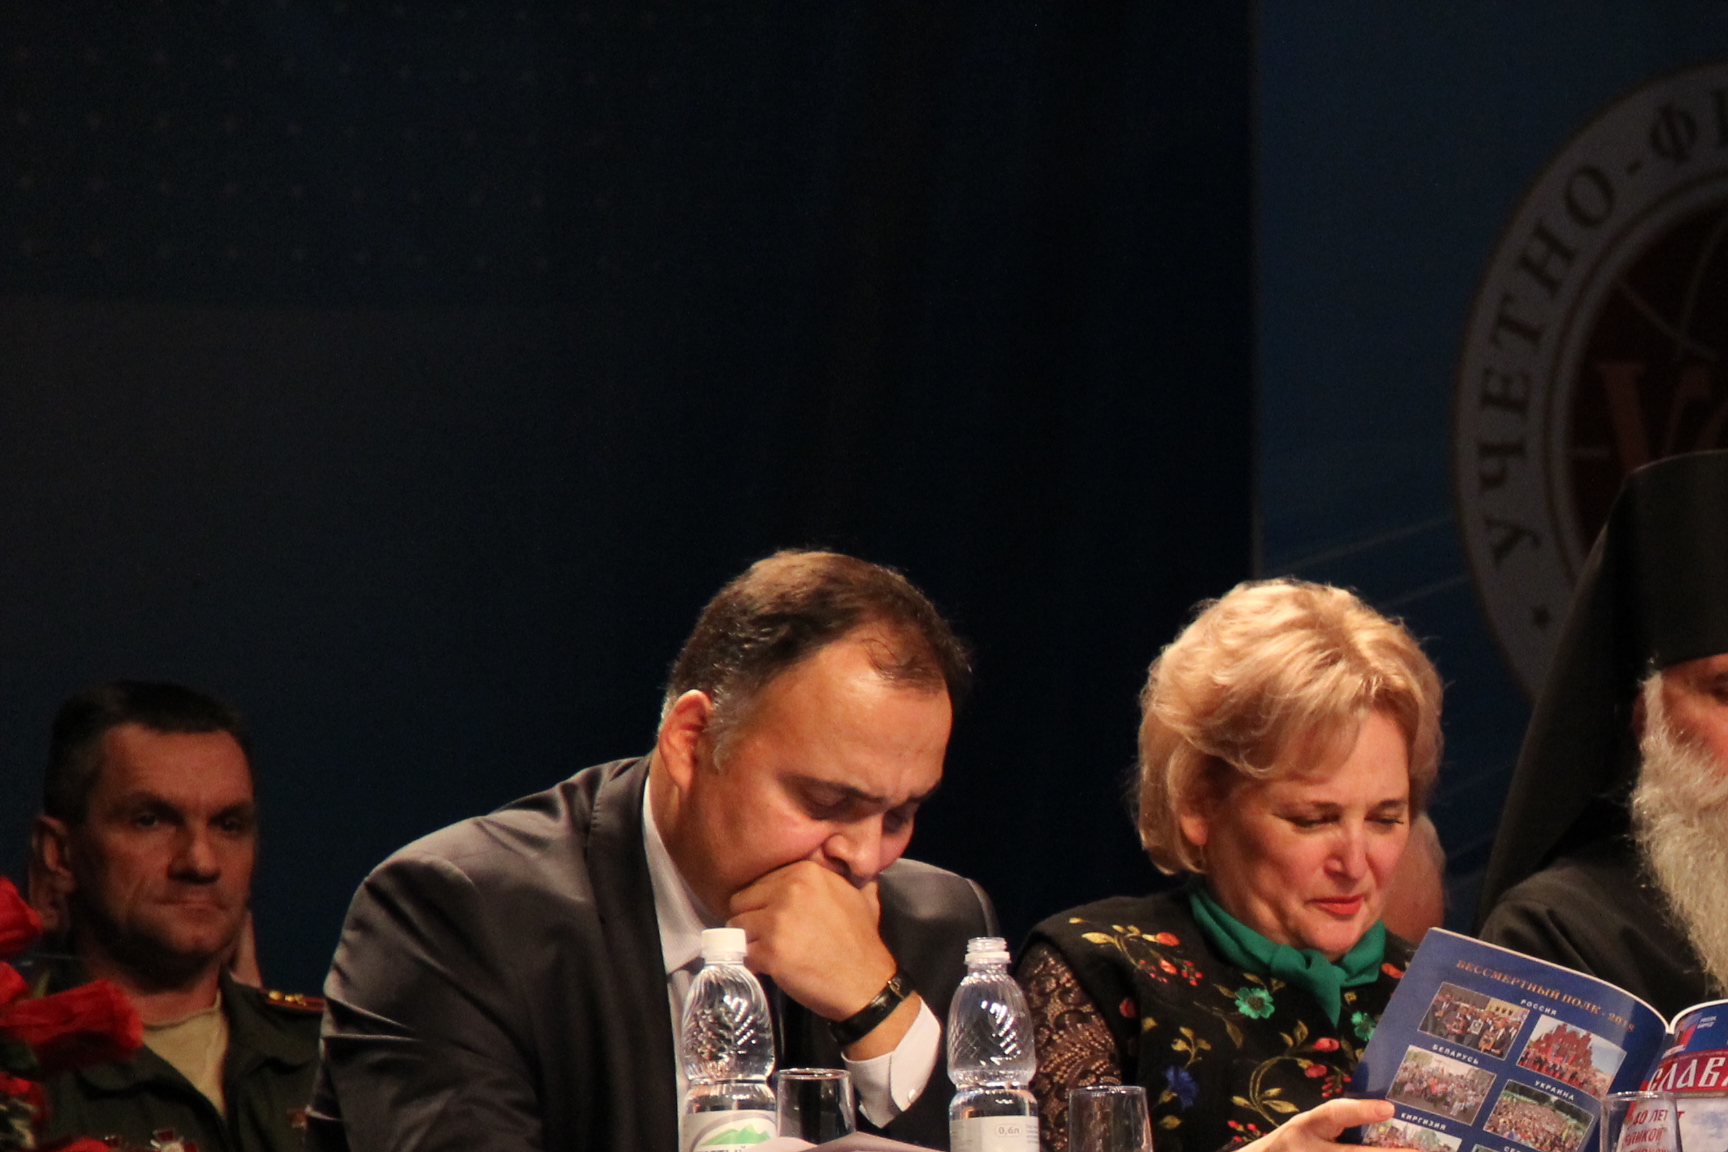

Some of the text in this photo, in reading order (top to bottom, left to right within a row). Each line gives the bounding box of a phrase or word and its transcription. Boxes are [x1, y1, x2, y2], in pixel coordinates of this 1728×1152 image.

[1456, 959, 1561, 1000] БЕССМЕРТНЫЙ
[1561, 992, 1602, 1015] ПОЛК
[1520, 999, 1557, 1016] РОССИЯ
[1432, 1044, 1480, 1065] БЕЛАРУСЬ
[1534, 1080, 1575, 1101] УКРАИНА
[1400, 1113, 1447, 1131] КИРГИЗИЯ
